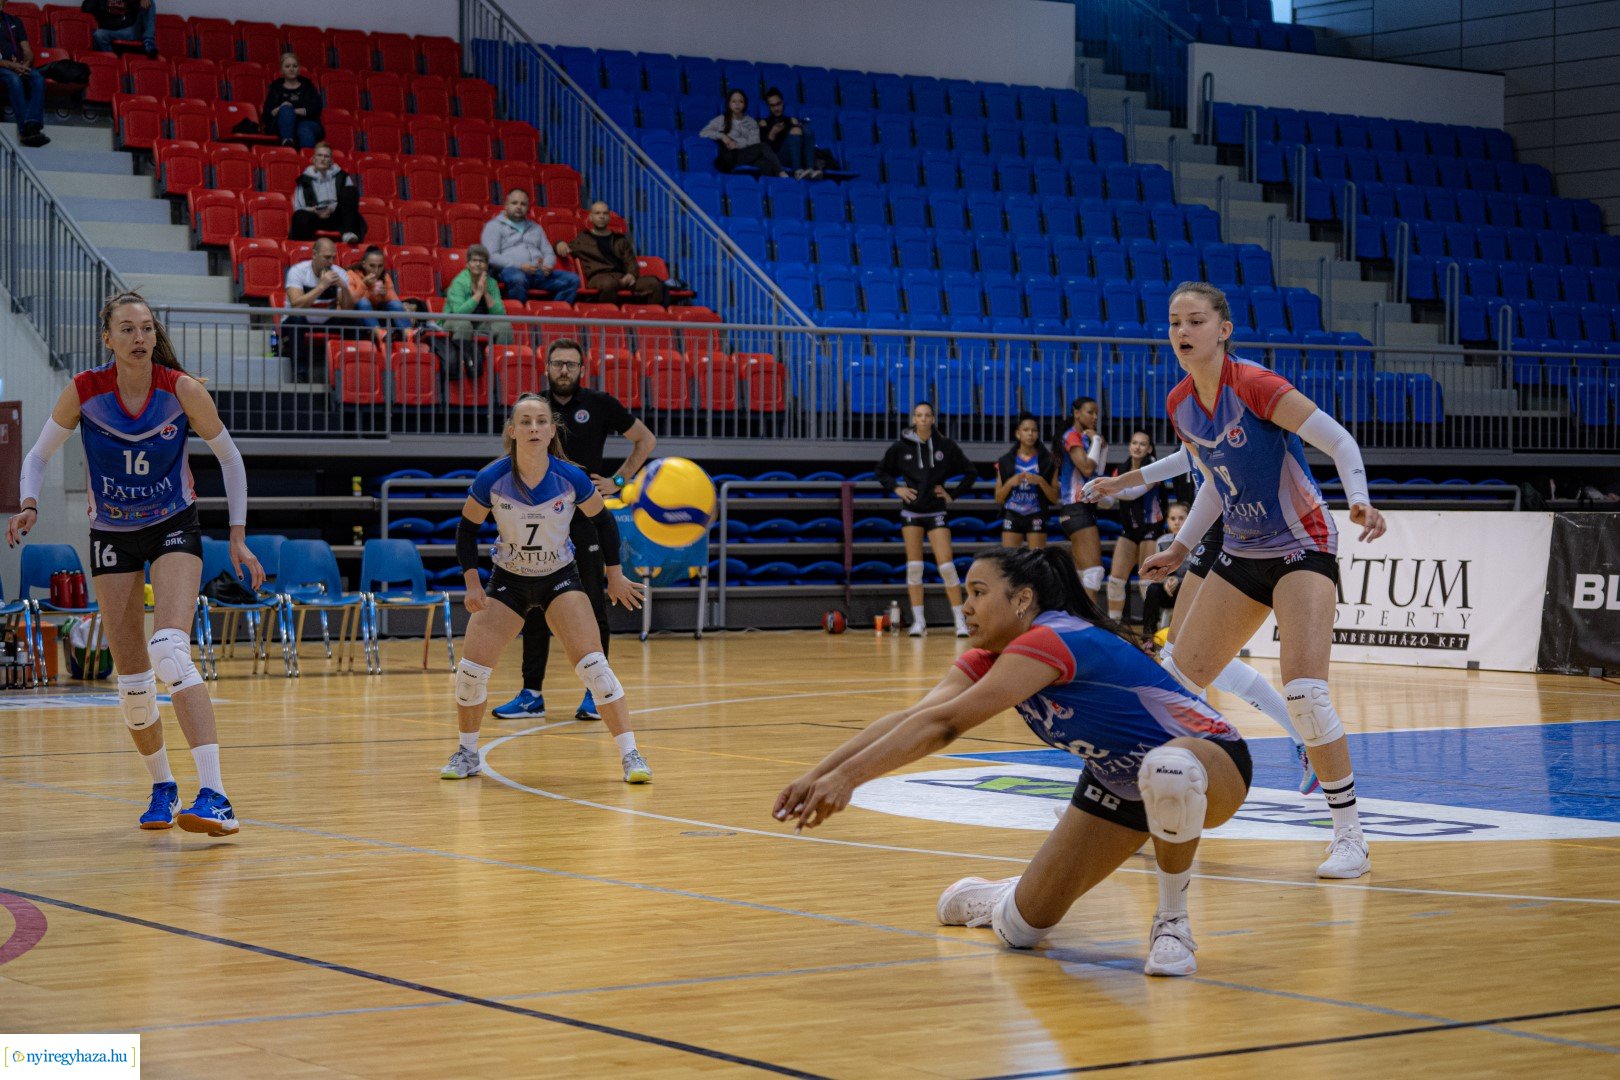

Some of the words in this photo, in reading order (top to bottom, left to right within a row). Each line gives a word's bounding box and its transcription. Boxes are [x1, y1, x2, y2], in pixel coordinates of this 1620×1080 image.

[123, 449, 150, 475] 16
[101, 475, 173, 498] FATUM
[525, 523, 540, 545] 7
[93, 541, 118, 568] 16
[1573, 573, 1620, 610] BL
[1438, 635, 1467, 648] KFT
[1156, 765, 1184, 775] MIKASA
